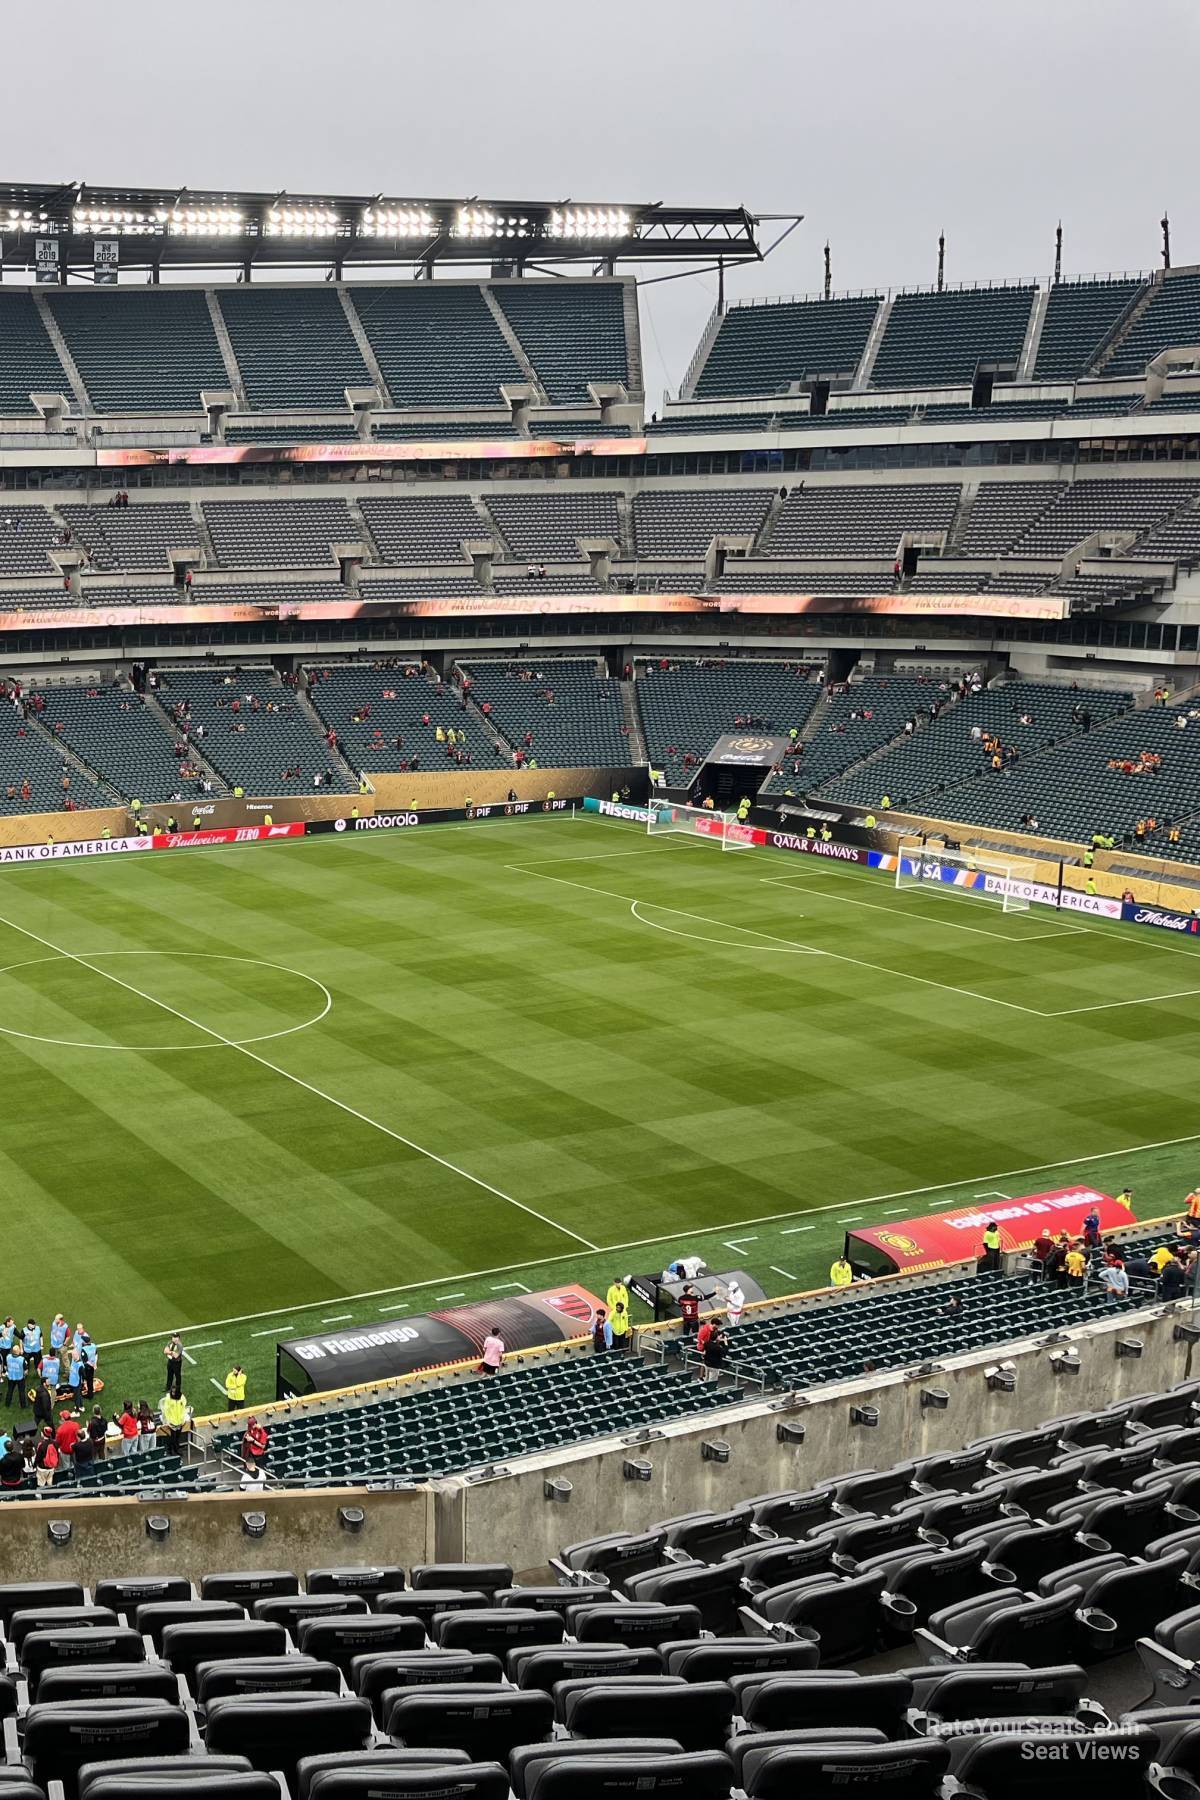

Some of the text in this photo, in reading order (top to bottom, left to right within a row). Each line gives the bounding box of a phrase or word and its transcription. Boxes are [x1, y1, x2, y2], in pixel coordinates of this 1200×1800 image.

[38, 250, 56, 260] 2019
[96, 253, 116, 261] 2022
[476, 807, 491, 817] PIF
[514, 803, 529, 814] PIF
[552, 800, 567, 810] PIF
[598, 800, 657, 823] Hisense
[355, 812, 419, 830] motorola
[166, 828, 260, 847] Budweiser ZERO
[40, 844, 58, 857] OF
[63, 840, 129, 855] AMERICA
[772, 834, 859, 861] QATAR AIRWAYS
[1023, 887, 1038, 898] OF
[1134, 909, 1189, 930] Michelob
[294, 1327, 420, 1360] CR Flamengo
